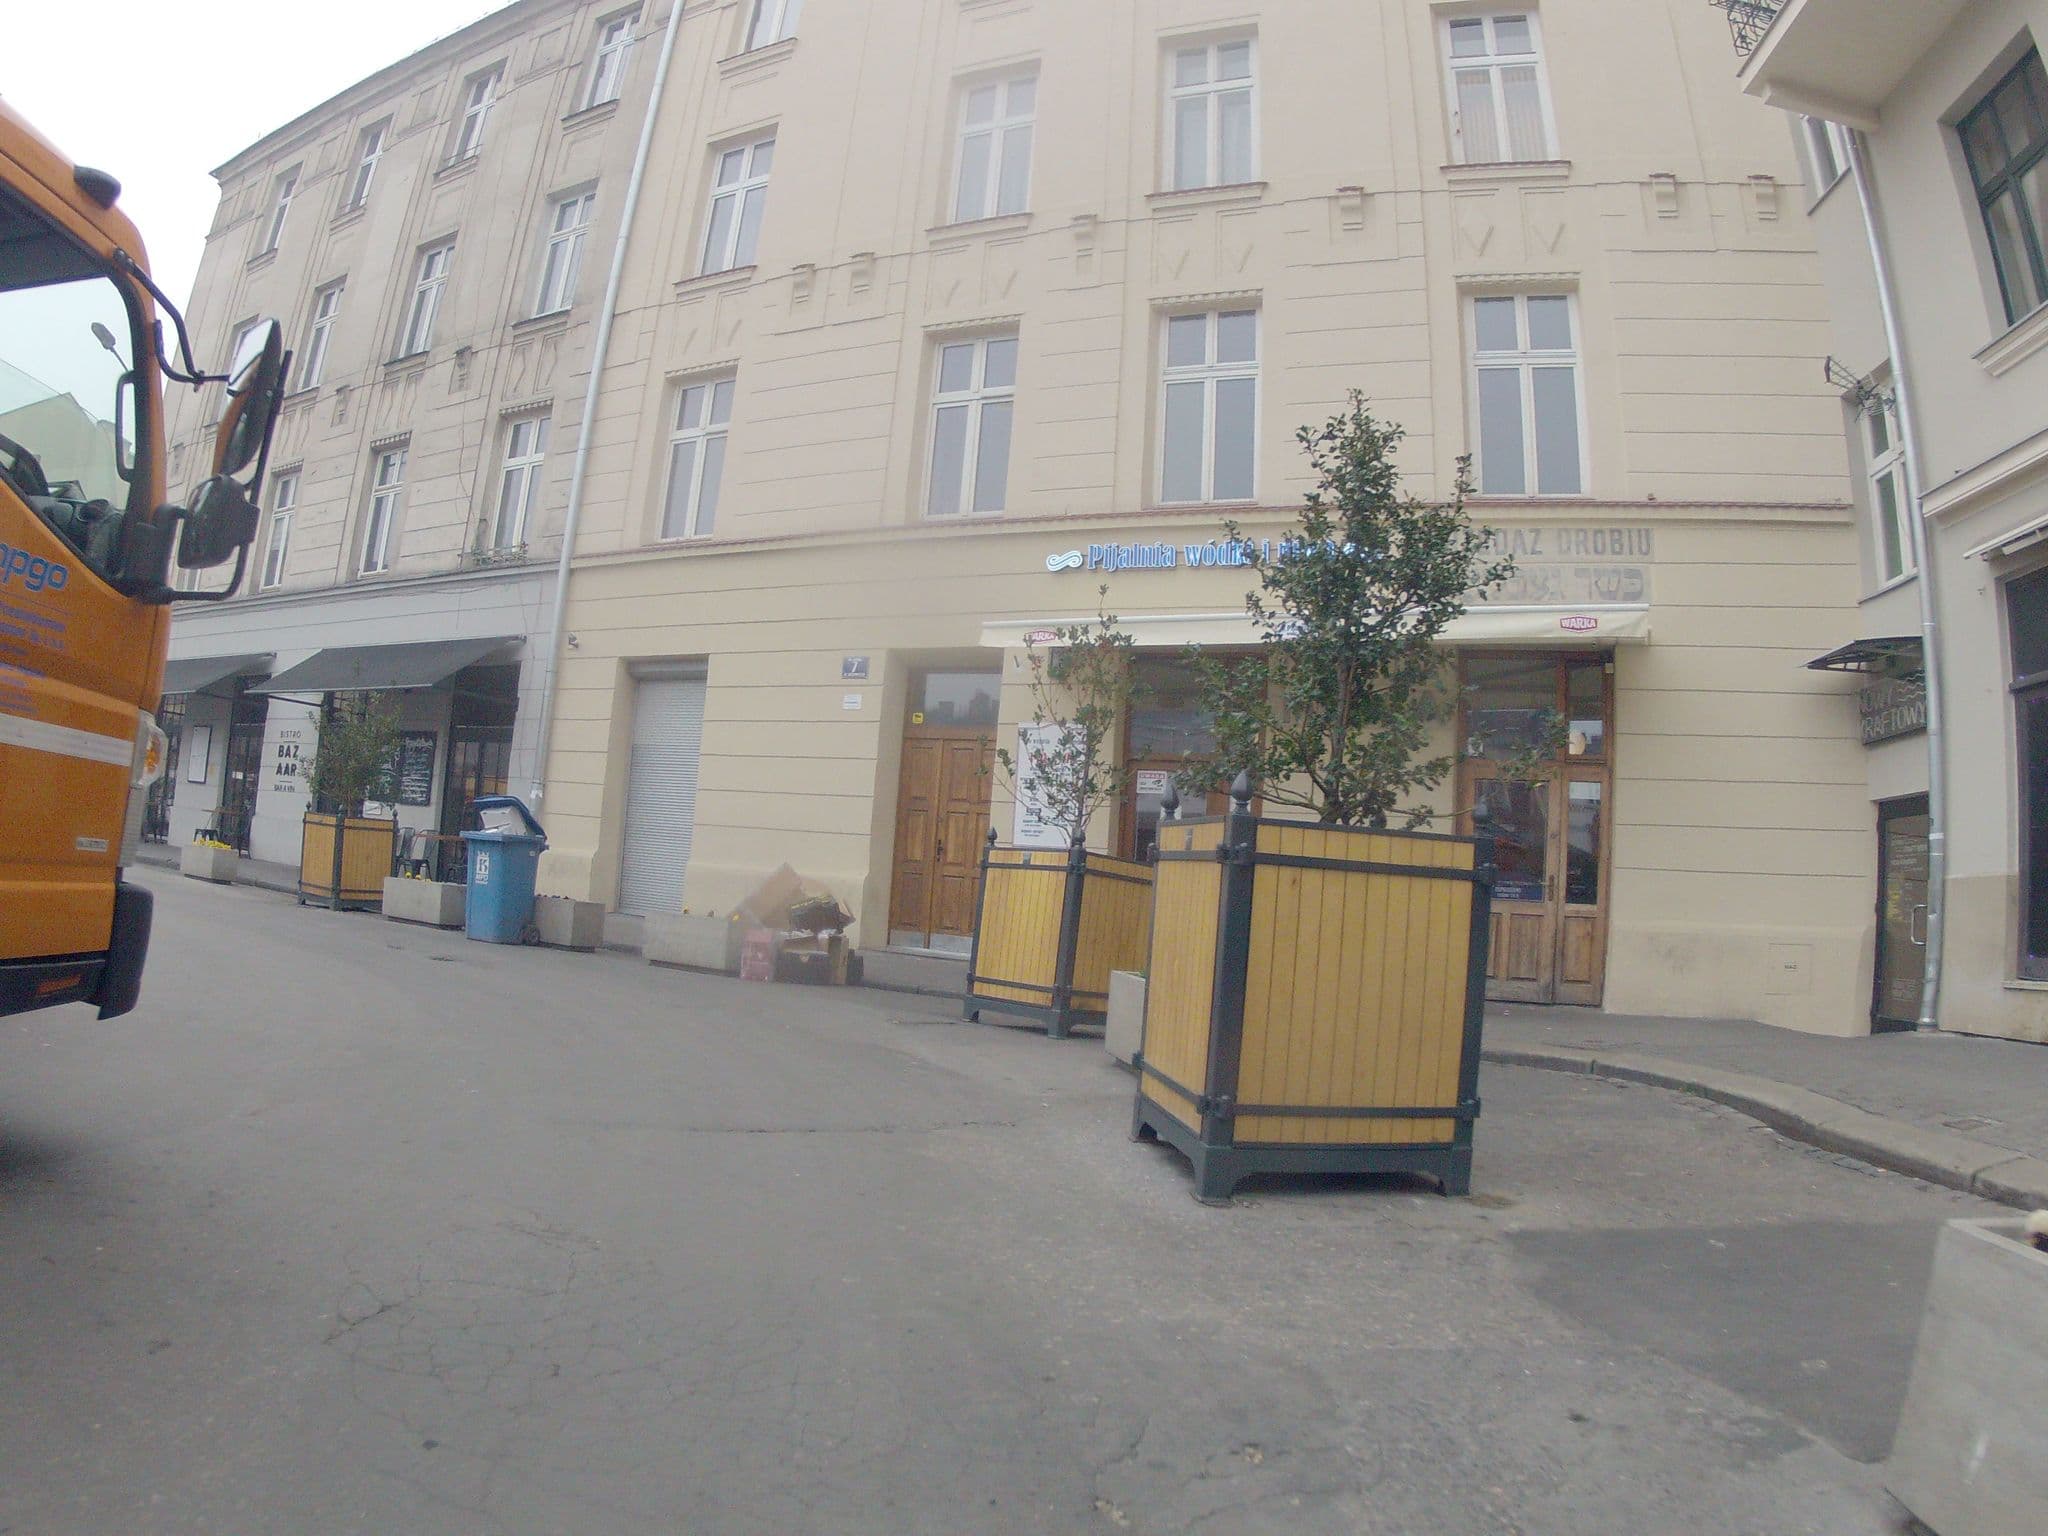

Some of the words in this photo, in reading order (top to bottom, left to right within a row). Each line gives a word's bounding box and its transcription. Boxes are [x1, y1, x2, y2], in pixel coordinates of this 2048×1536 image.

[1557, 527, 1652, 556] DROBIU
[1086, 541, 1177, 573] Pijalnia
[1561, 617, 1597, 630] WARKA
[278, 744, 300, 759] BAZ
[276, 762, 298, 777] AAR
